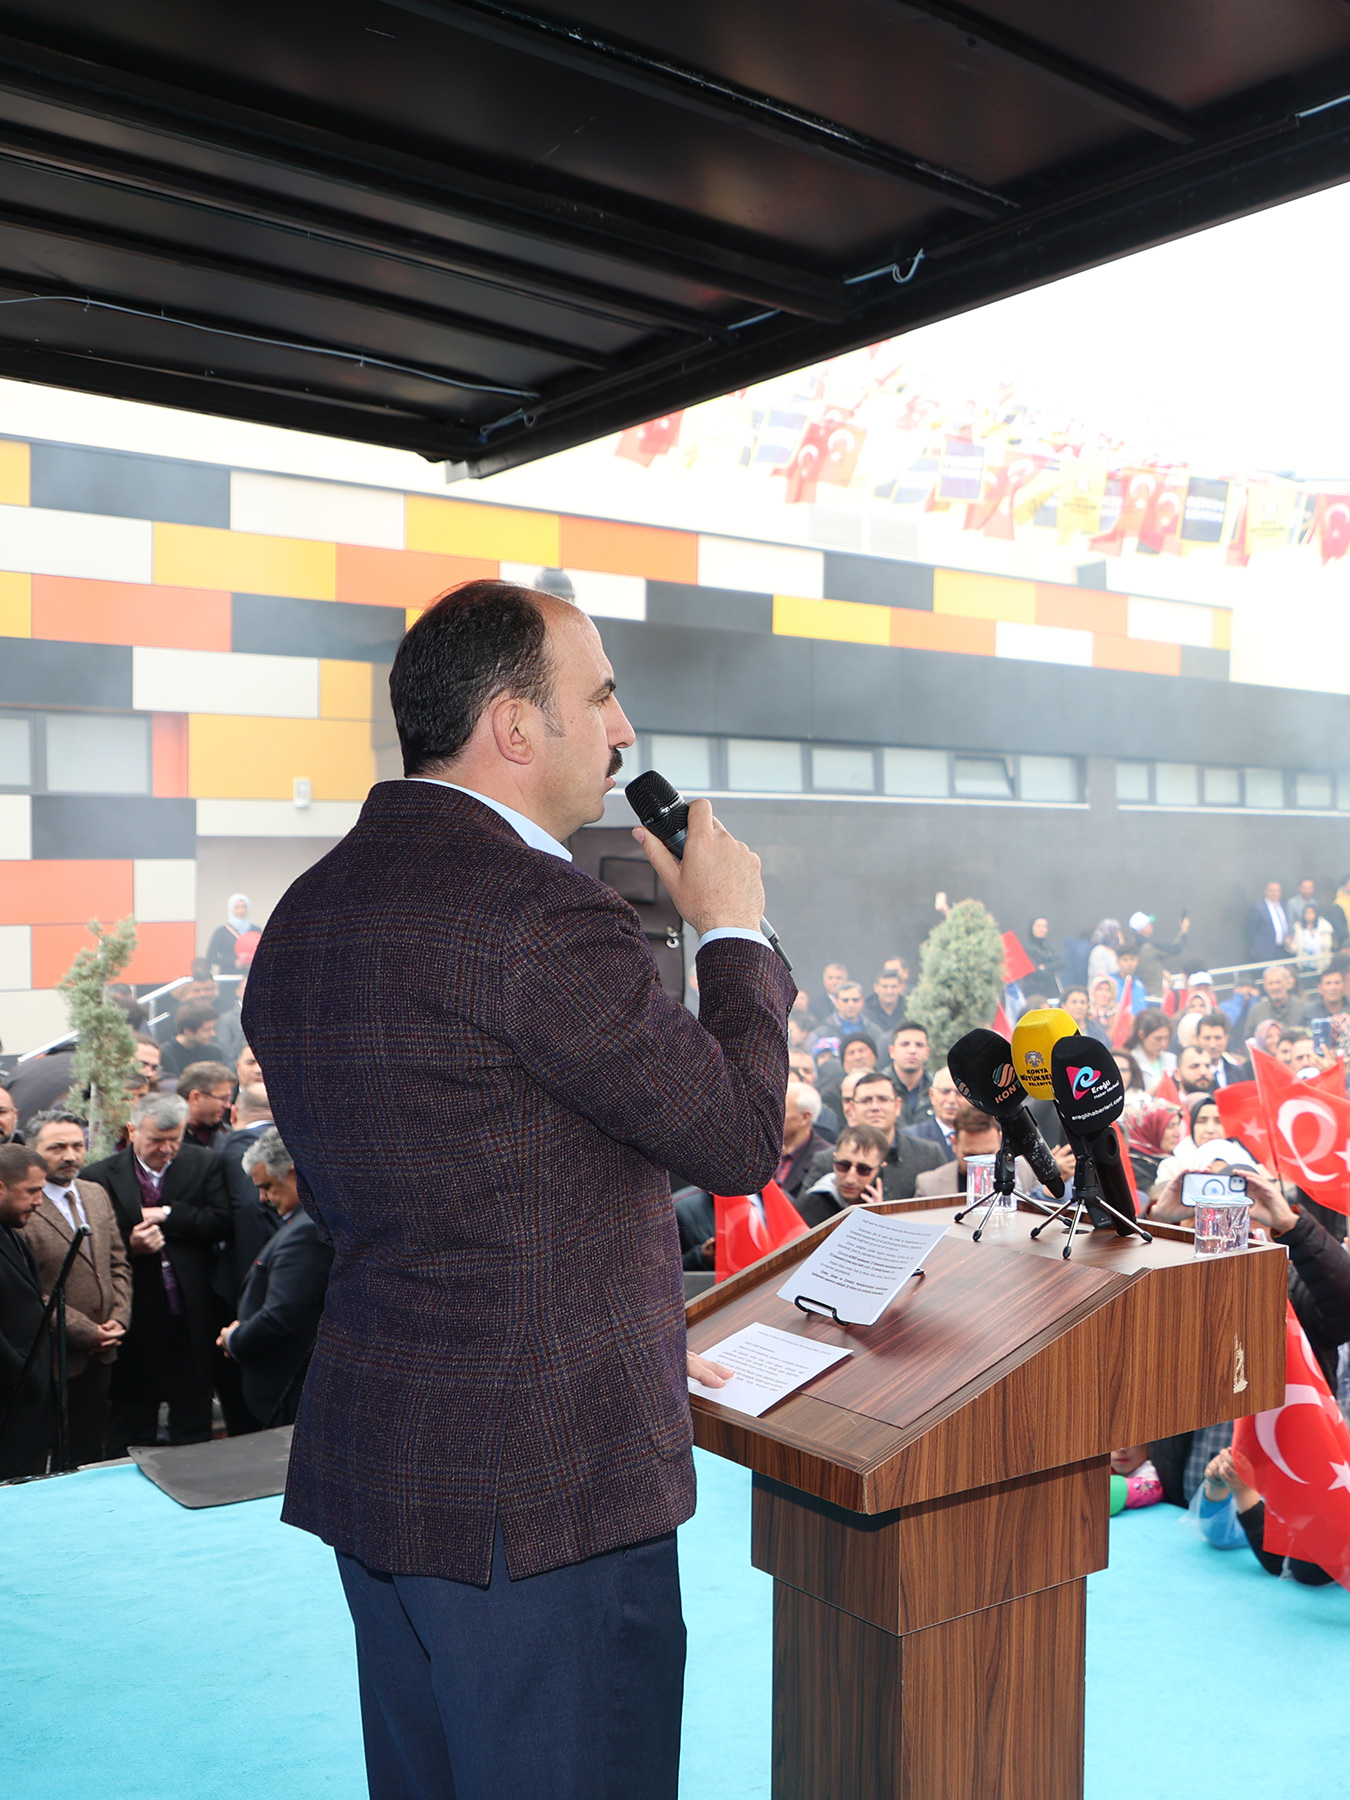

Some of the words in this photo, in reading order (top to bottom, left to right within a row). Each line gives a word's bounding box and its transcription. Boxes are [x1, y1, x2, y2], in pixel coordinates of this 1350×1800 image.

[1020, 1073, 1053, 1082] BÜYÜKŞE
[1091, 1080, 1111, 1094] Ereğli
[1093, 1090, 1107, 1099] Haber
